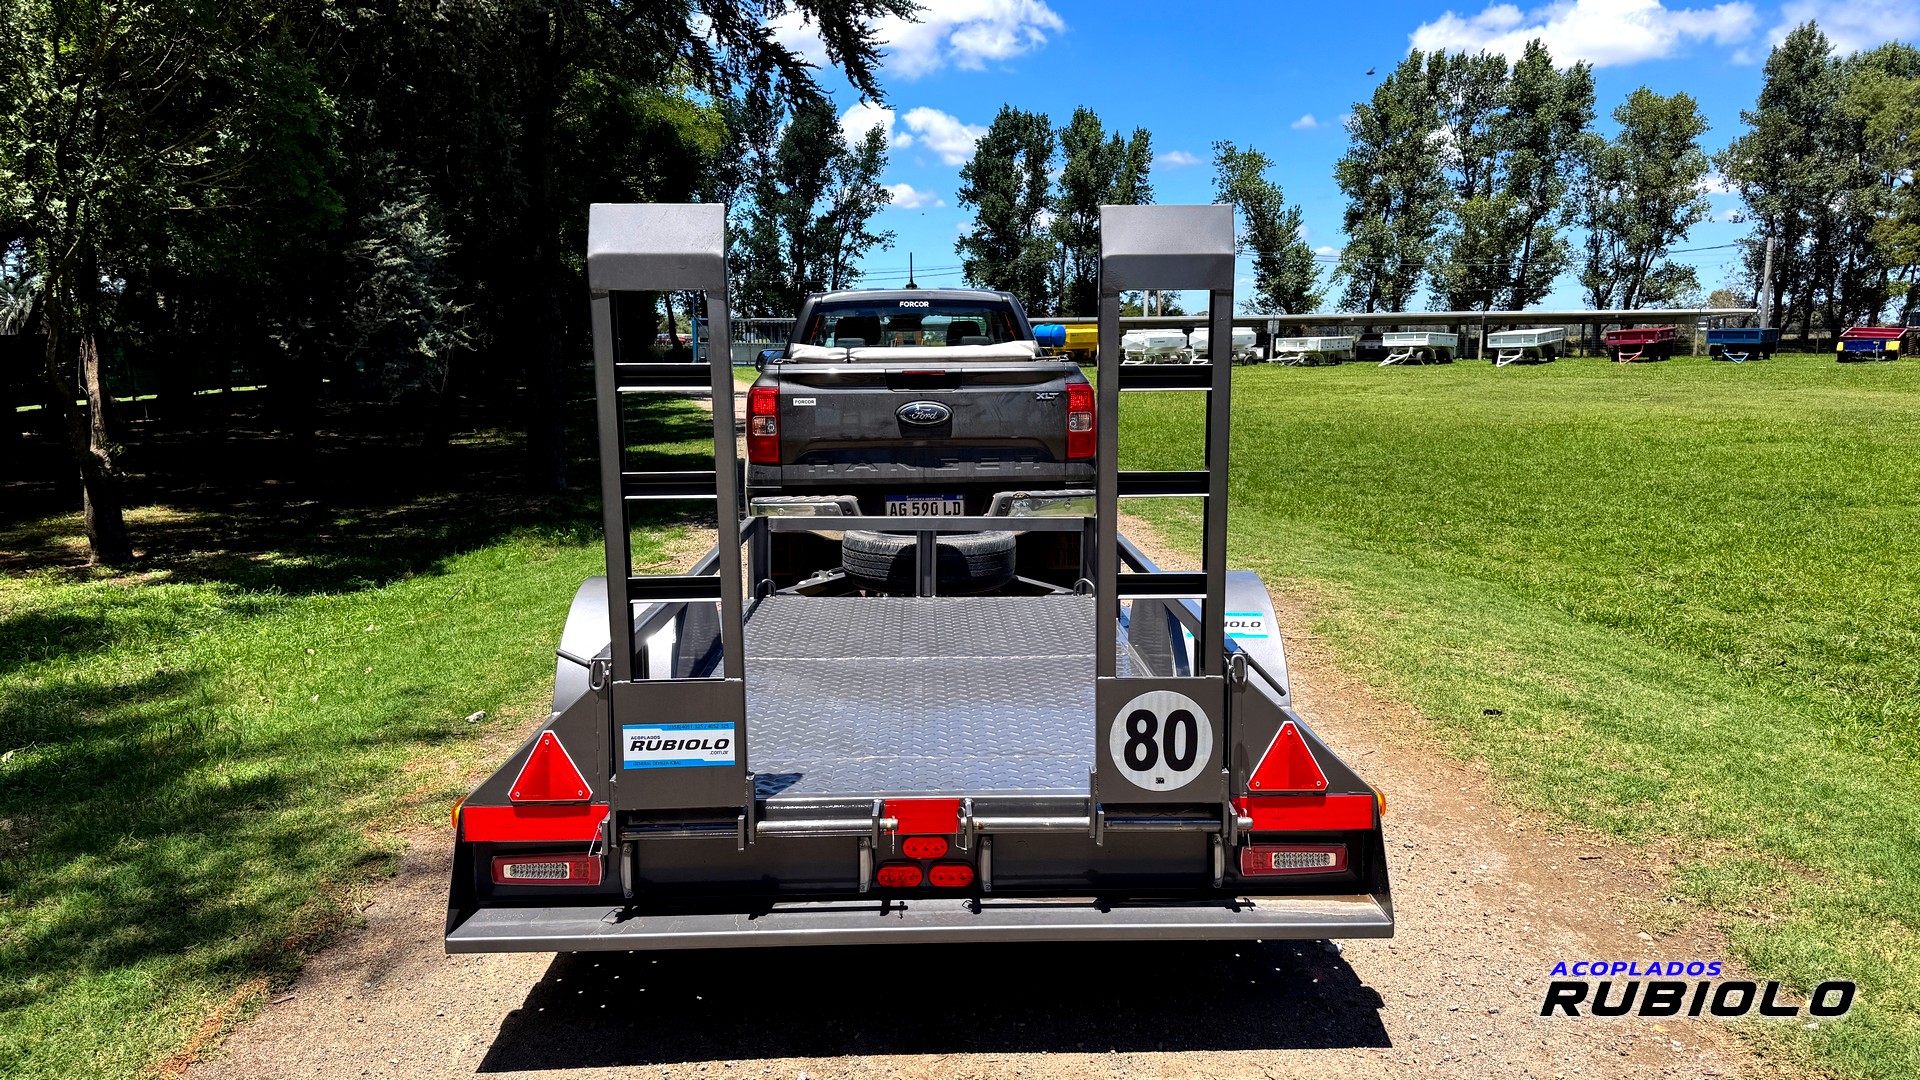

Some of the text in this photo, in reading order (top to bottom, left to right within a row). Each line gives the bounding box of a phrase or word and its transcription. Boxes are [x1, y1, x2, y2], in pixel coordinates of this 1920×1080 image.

[1036, 392, 1060, 400] XLT
[910, 408, 938, 420] Ford
[808, 456, 1041, 474] RANGER
[890, 501, 961, 516] AG 590 LD
[630, 738, 730, 752] RUBIOLO
[1123, 709, 1199, 772] 80
